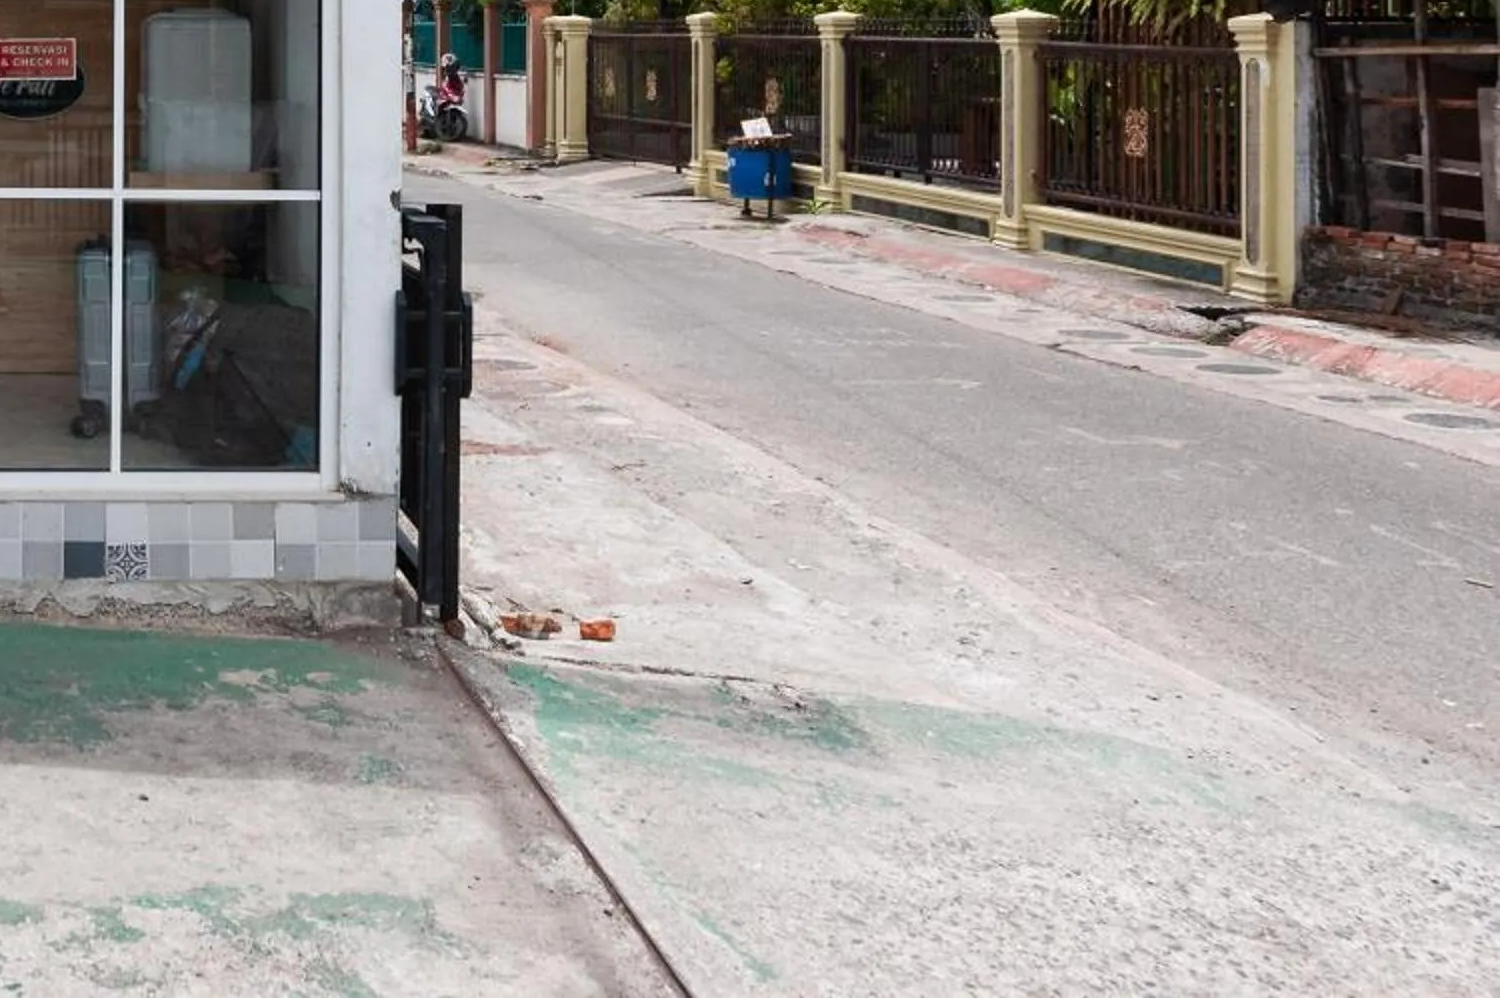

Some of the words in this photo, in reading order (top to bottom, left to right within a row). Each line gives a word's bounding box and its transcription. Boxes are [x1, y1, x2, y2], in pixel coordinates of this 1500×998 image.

[1, 45, 68, 55] RESERVASI
[1, 57, 9, 67] &
[12, 57, 53, 67] CHECK
[56, 57, 69, 68] IN
